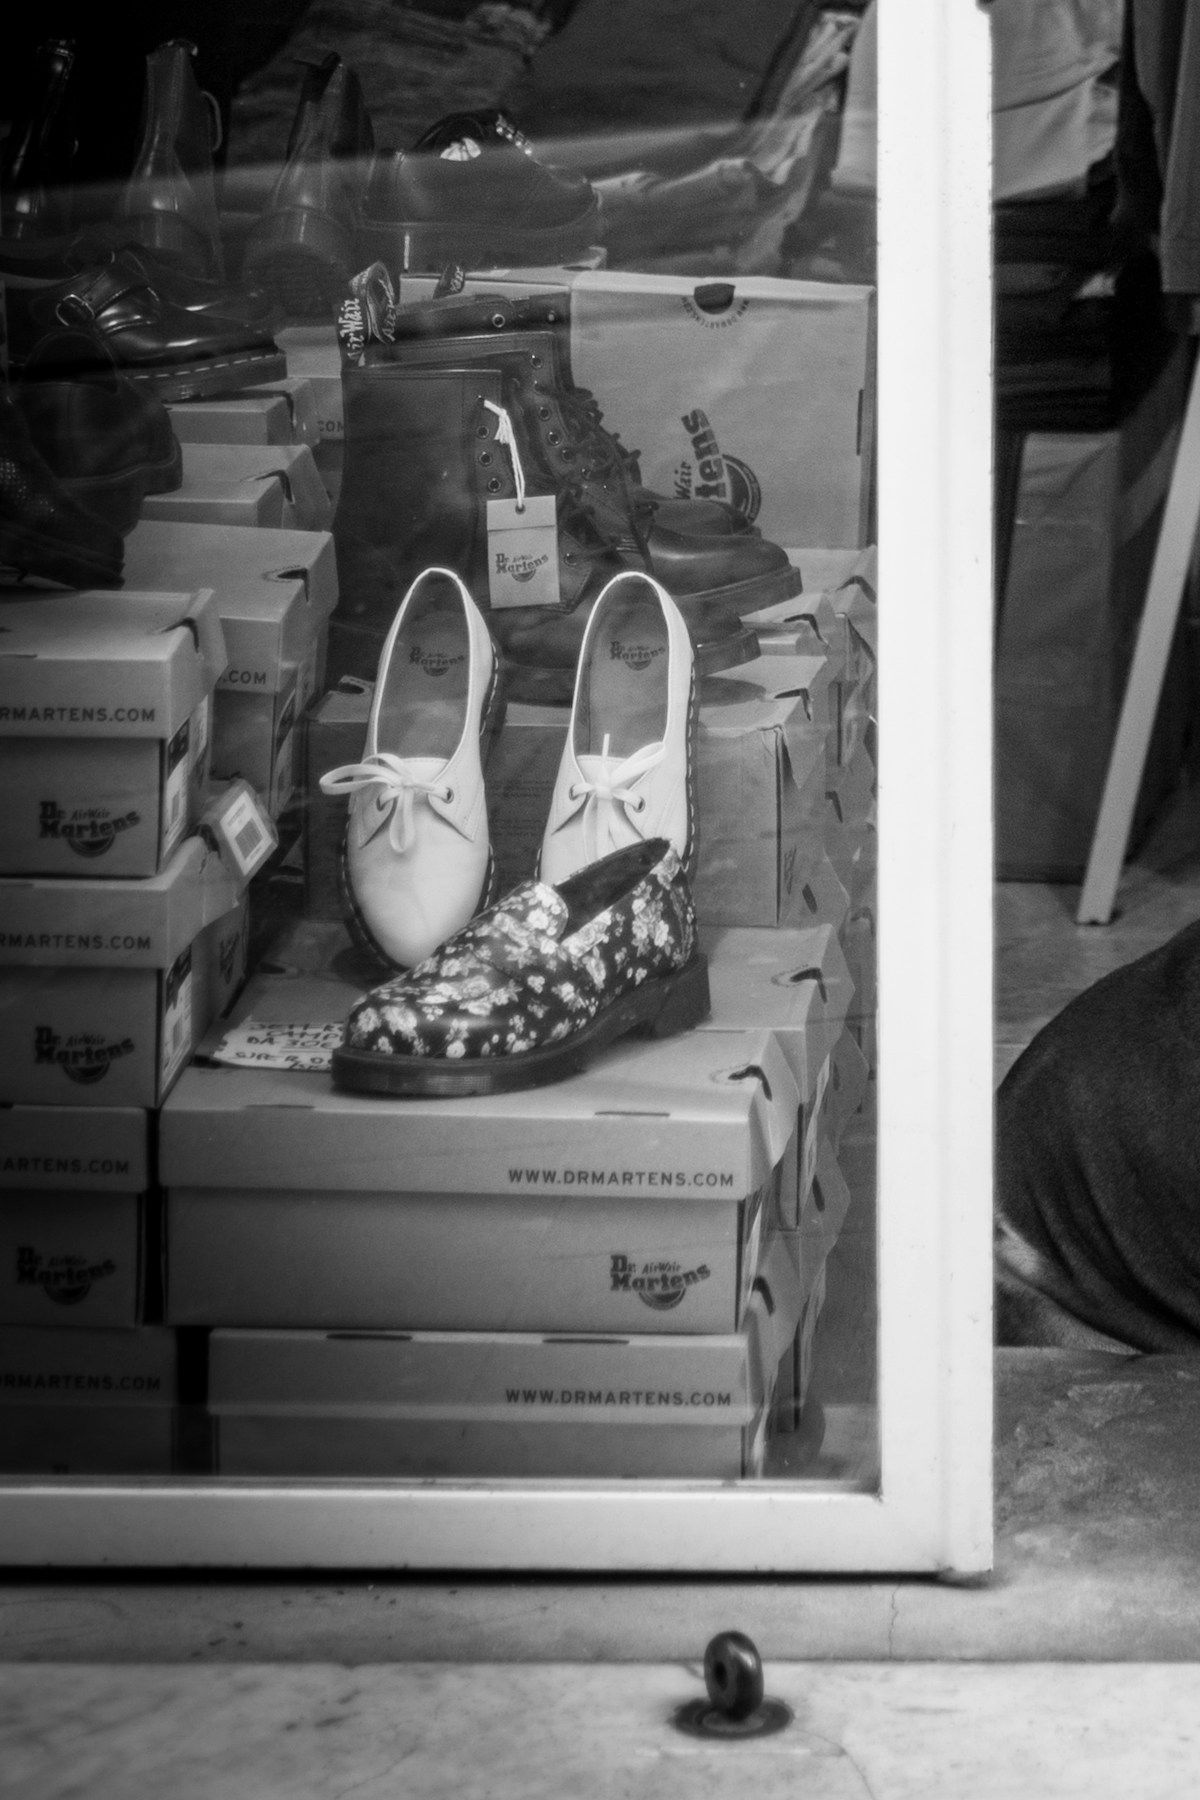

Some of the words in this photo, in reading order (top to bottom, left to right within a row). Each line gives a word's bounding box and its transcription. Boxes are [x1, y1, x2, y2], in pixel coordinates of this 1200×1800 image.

[39, 811, 141, 838] Martens
[34, 1037, 136, 1064] Martens
[508, 1169, 735, 1187] WWW.DRMARTENS.COM
[610, 1264, 711, 1291] Martens
[0, 1374, 161, 1391] RMARTENS.COM
[505, 1388, 732, 1406] WWW.DRMARTENS.COM
